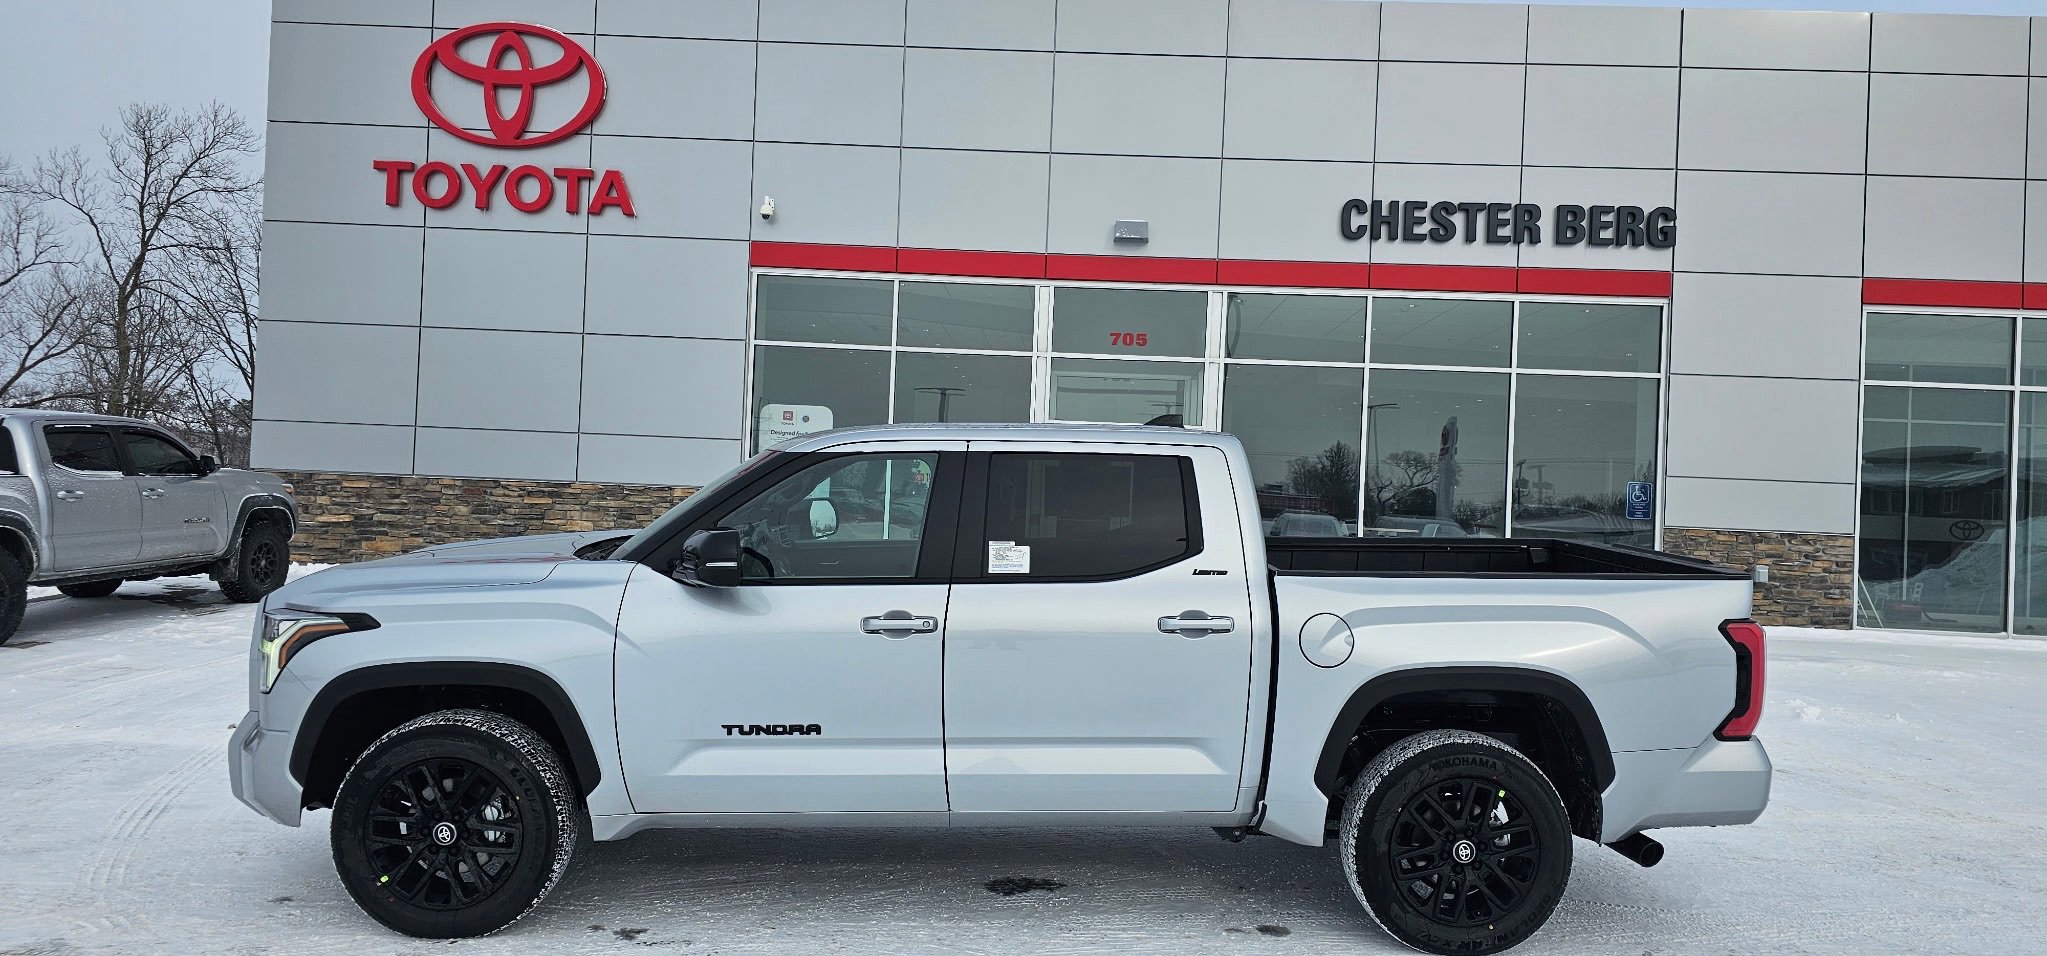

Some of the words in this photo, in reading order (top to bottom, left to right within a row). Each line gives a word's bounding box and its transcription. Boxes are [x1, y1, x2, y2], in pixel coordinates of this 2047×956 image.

[373, 160, 637, 217] TOYOTA
[1341, 199, 1542, 245] CHESTER
[1556, 205, 1677, 249] BERG
[1109, 332, 1148, 347] 705
[770, 429, 795, 437] Designed
[721, 724, 822, 736] TUNDRA
